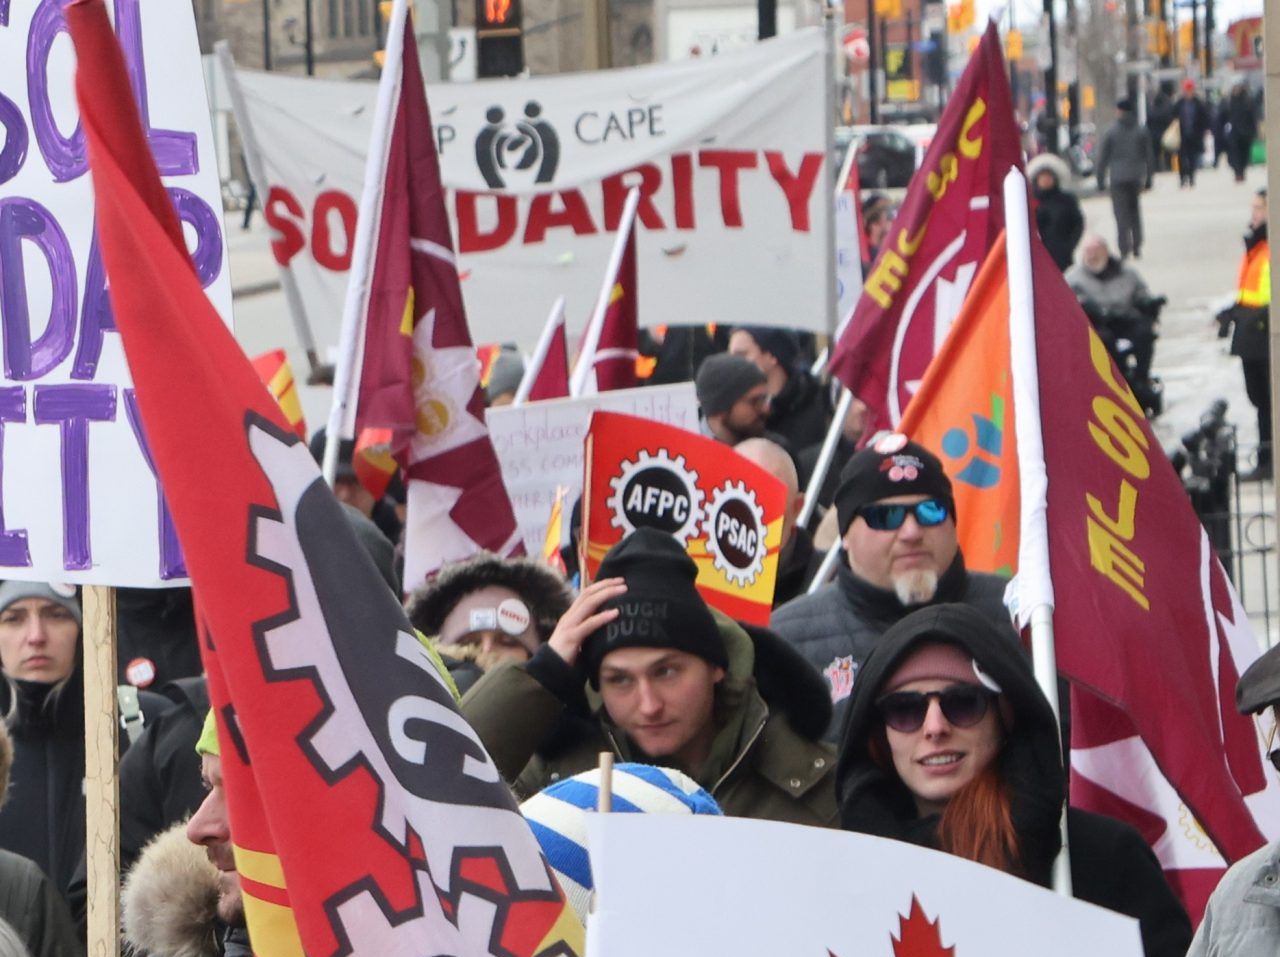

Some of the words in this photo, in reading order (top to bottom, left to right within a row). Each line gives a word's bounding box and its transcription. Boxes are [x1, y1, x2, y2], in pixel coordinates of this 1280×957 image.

[574, 103, 666, 144] CAPE
[265, 149, 825, 272] SODARITY
[626, 483, 689, 523] AFPC
[718, 512, 756, 557] PSAC
